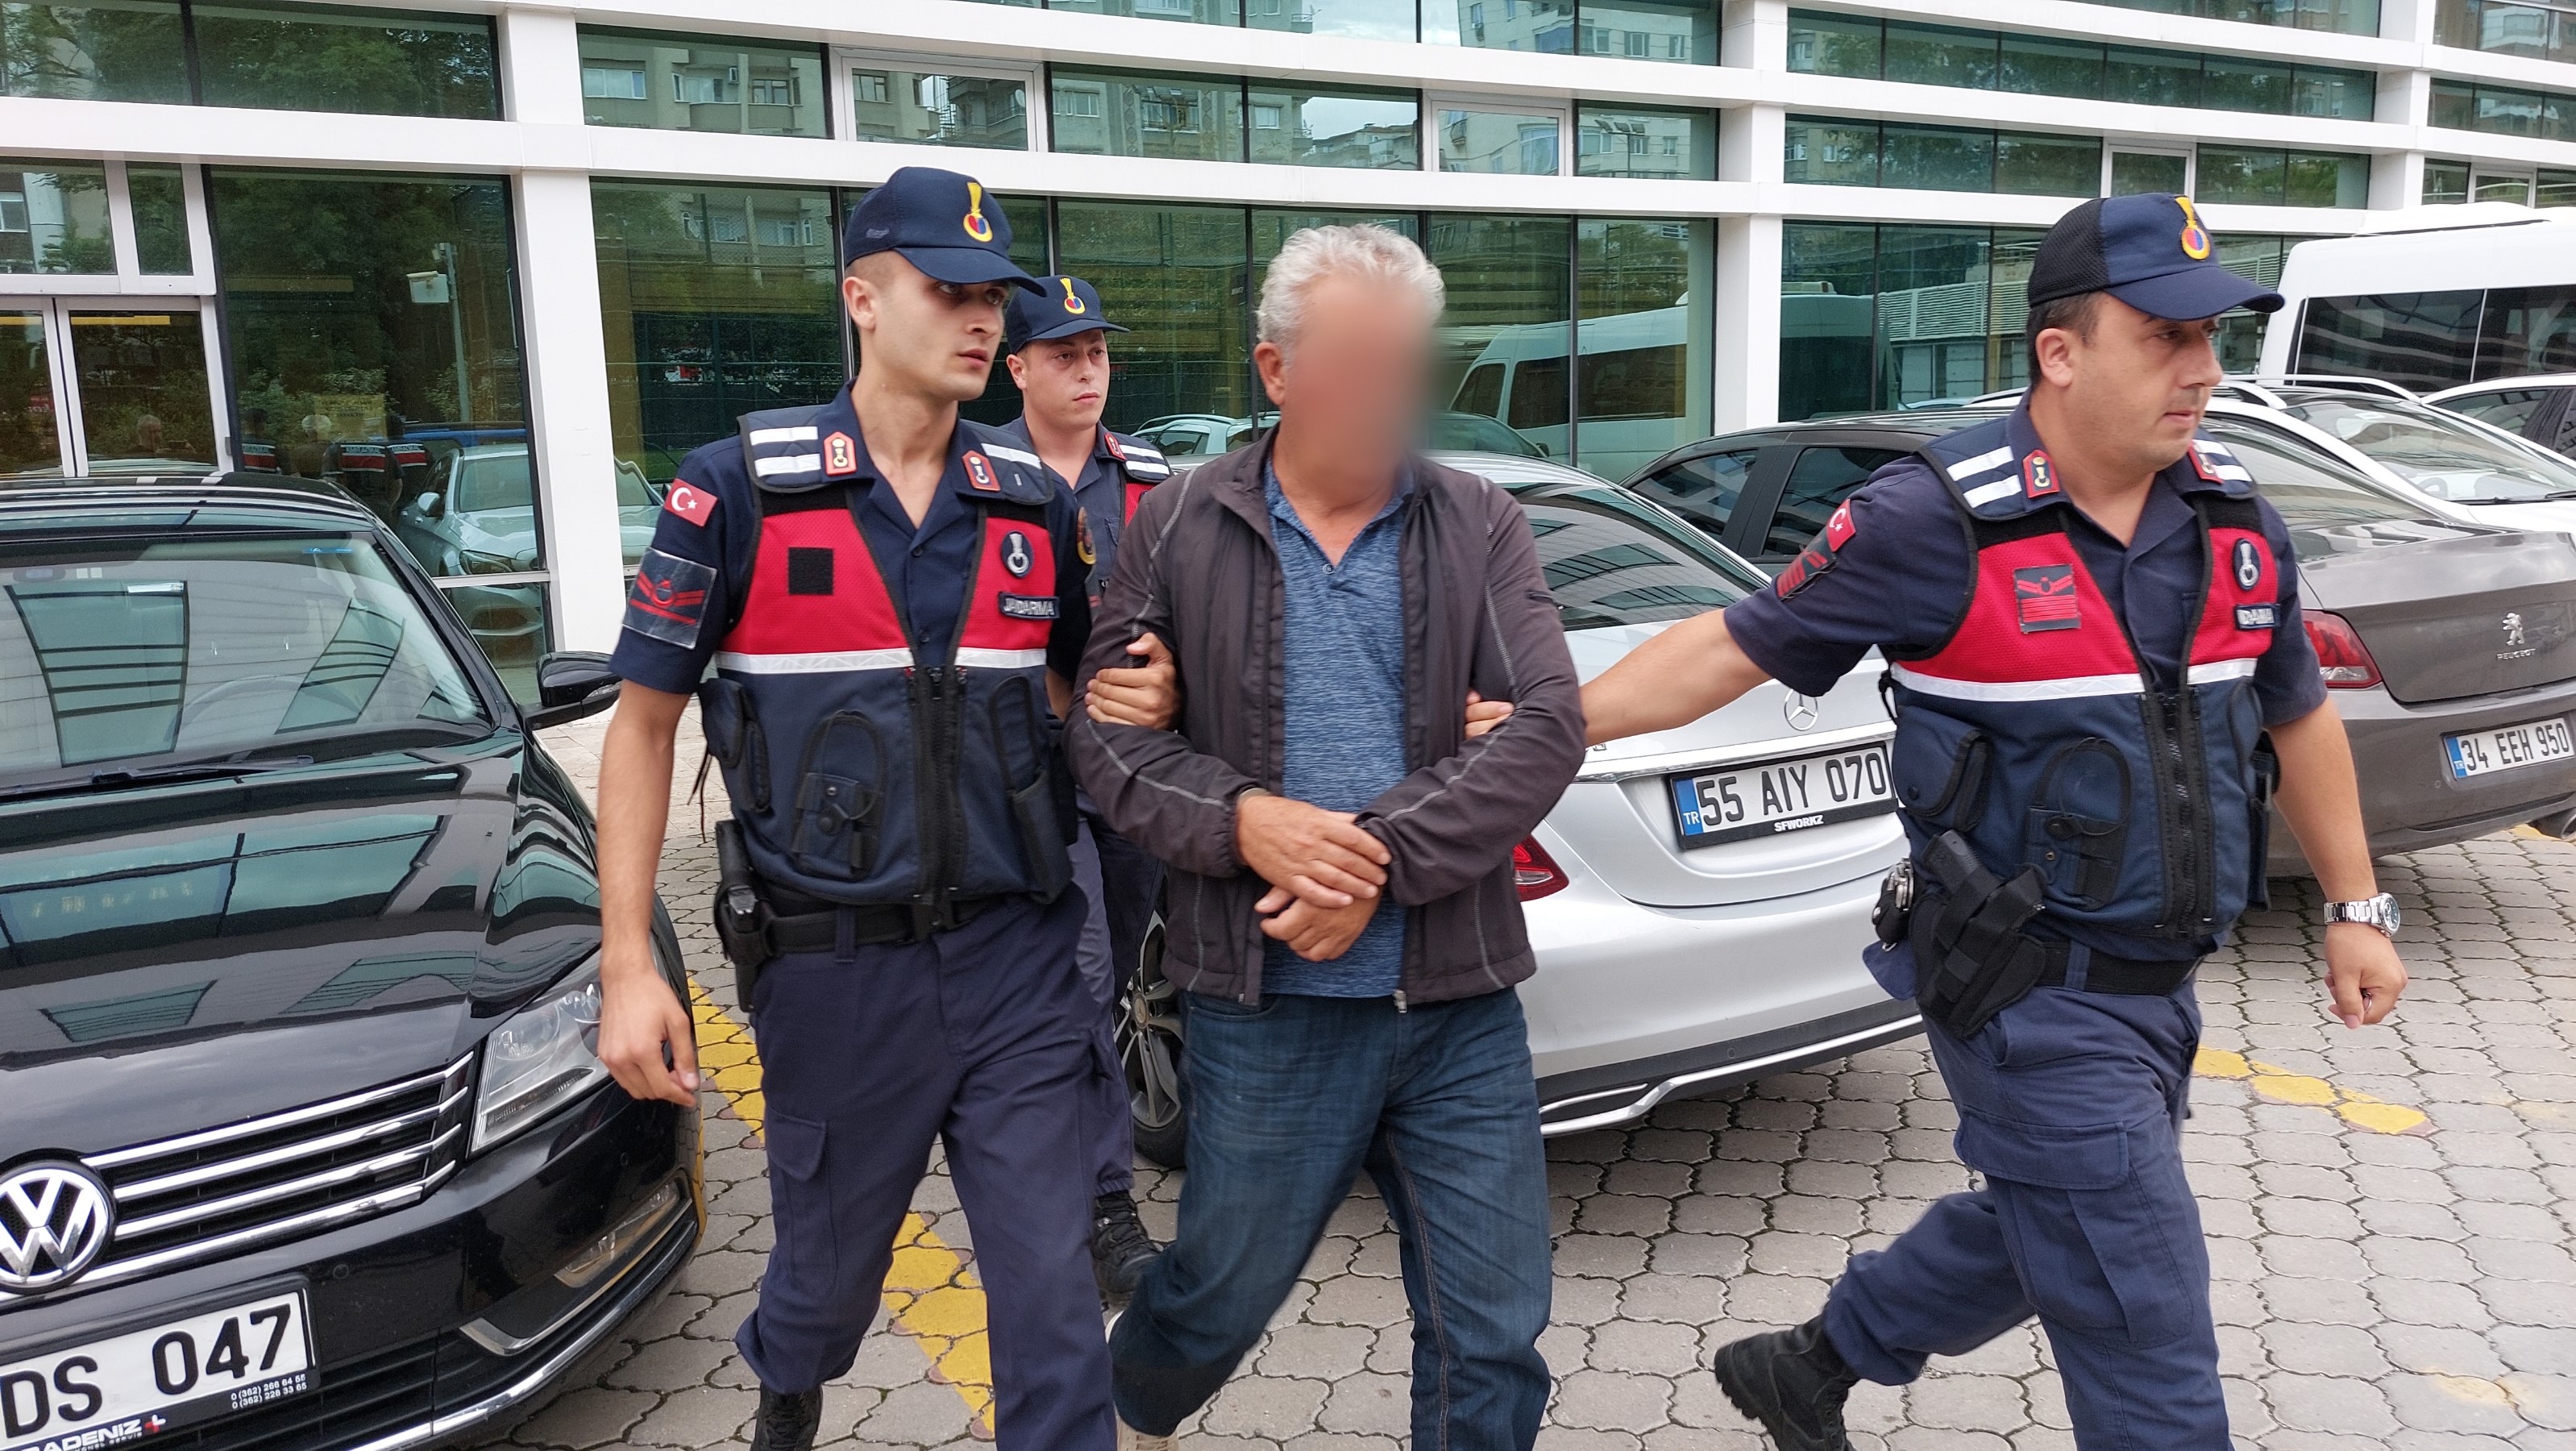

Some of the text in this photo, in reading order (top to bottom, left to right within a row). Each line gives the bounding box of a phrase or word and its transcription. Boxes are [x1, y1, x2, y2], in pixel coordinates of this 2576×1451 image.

[2496, 648, 2537, 660] PEUGEOT
[2461, 723, 2570, 771] 34 EEH 950
[1697, 753, 1887, 826] 55 AIY 070
[1683, 811, 1701, 825] TR
[1774, 815, 1824, 832] SFWORKZ
[0, 1303, 292, 1439] DS 047
[231, 1392, 237, 1401] 0
[239, 1385, 262, 1400] (362)
[232, 1401, 239, 1410] 0
[239, 1394, 263, 1408] (362)
